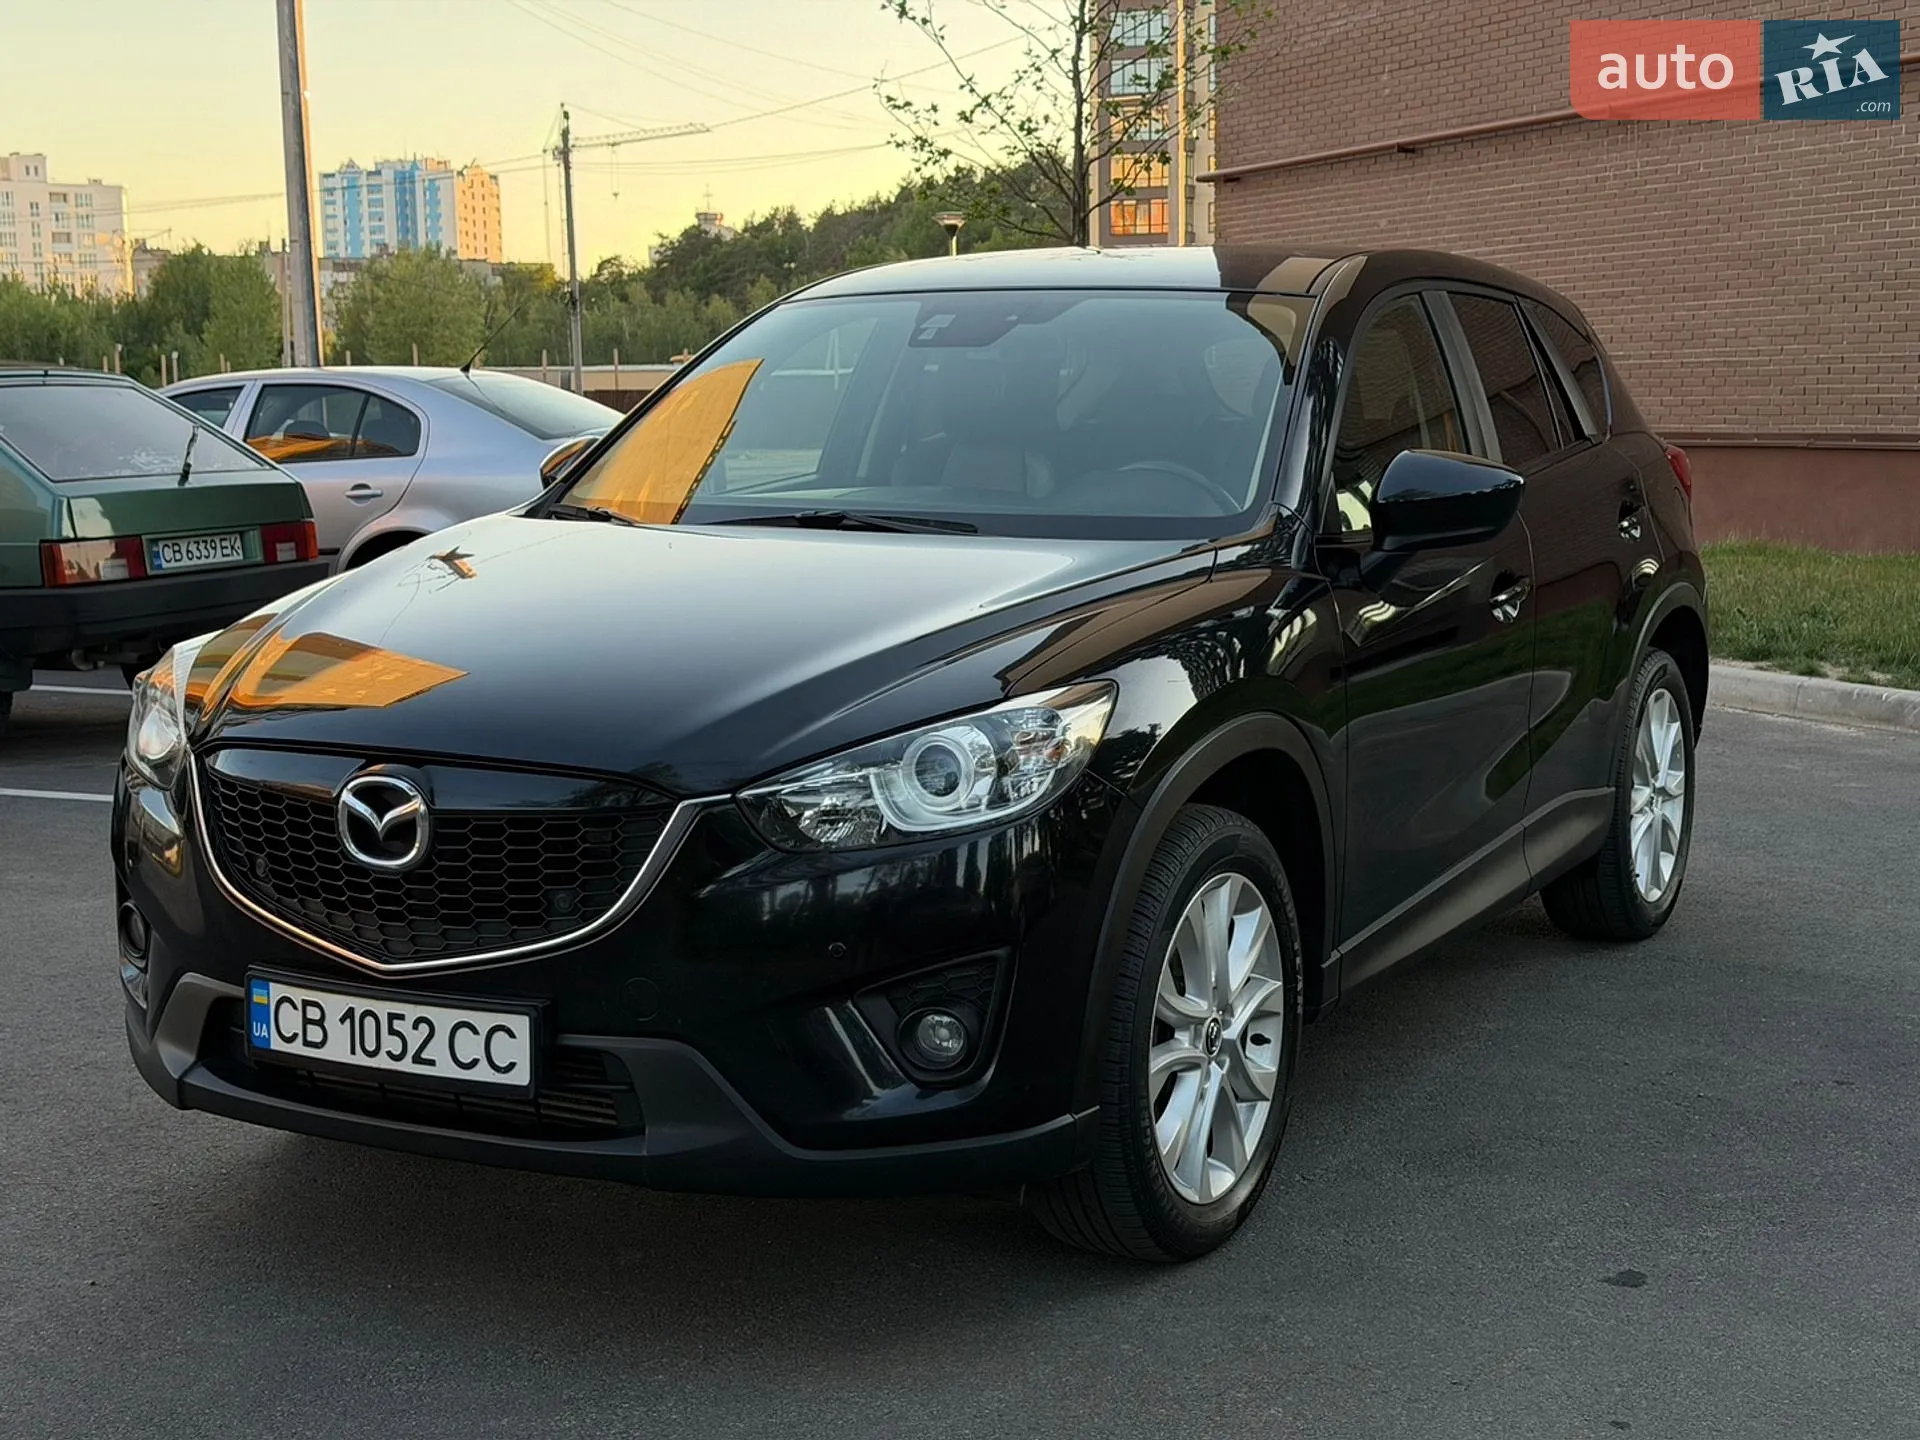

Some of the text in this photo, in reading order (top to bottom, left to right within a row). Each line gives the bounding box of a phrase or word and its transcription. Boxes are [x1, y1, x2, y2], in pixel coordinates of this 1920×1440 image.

[161, 542, 184, 563] CB
[186, 539, 218, 561] 6339
[219, 535, 241, 558] EK
[253, 1021, 269, 1039] UA
[273, 995, 518, 1074] CB 1052 CC
